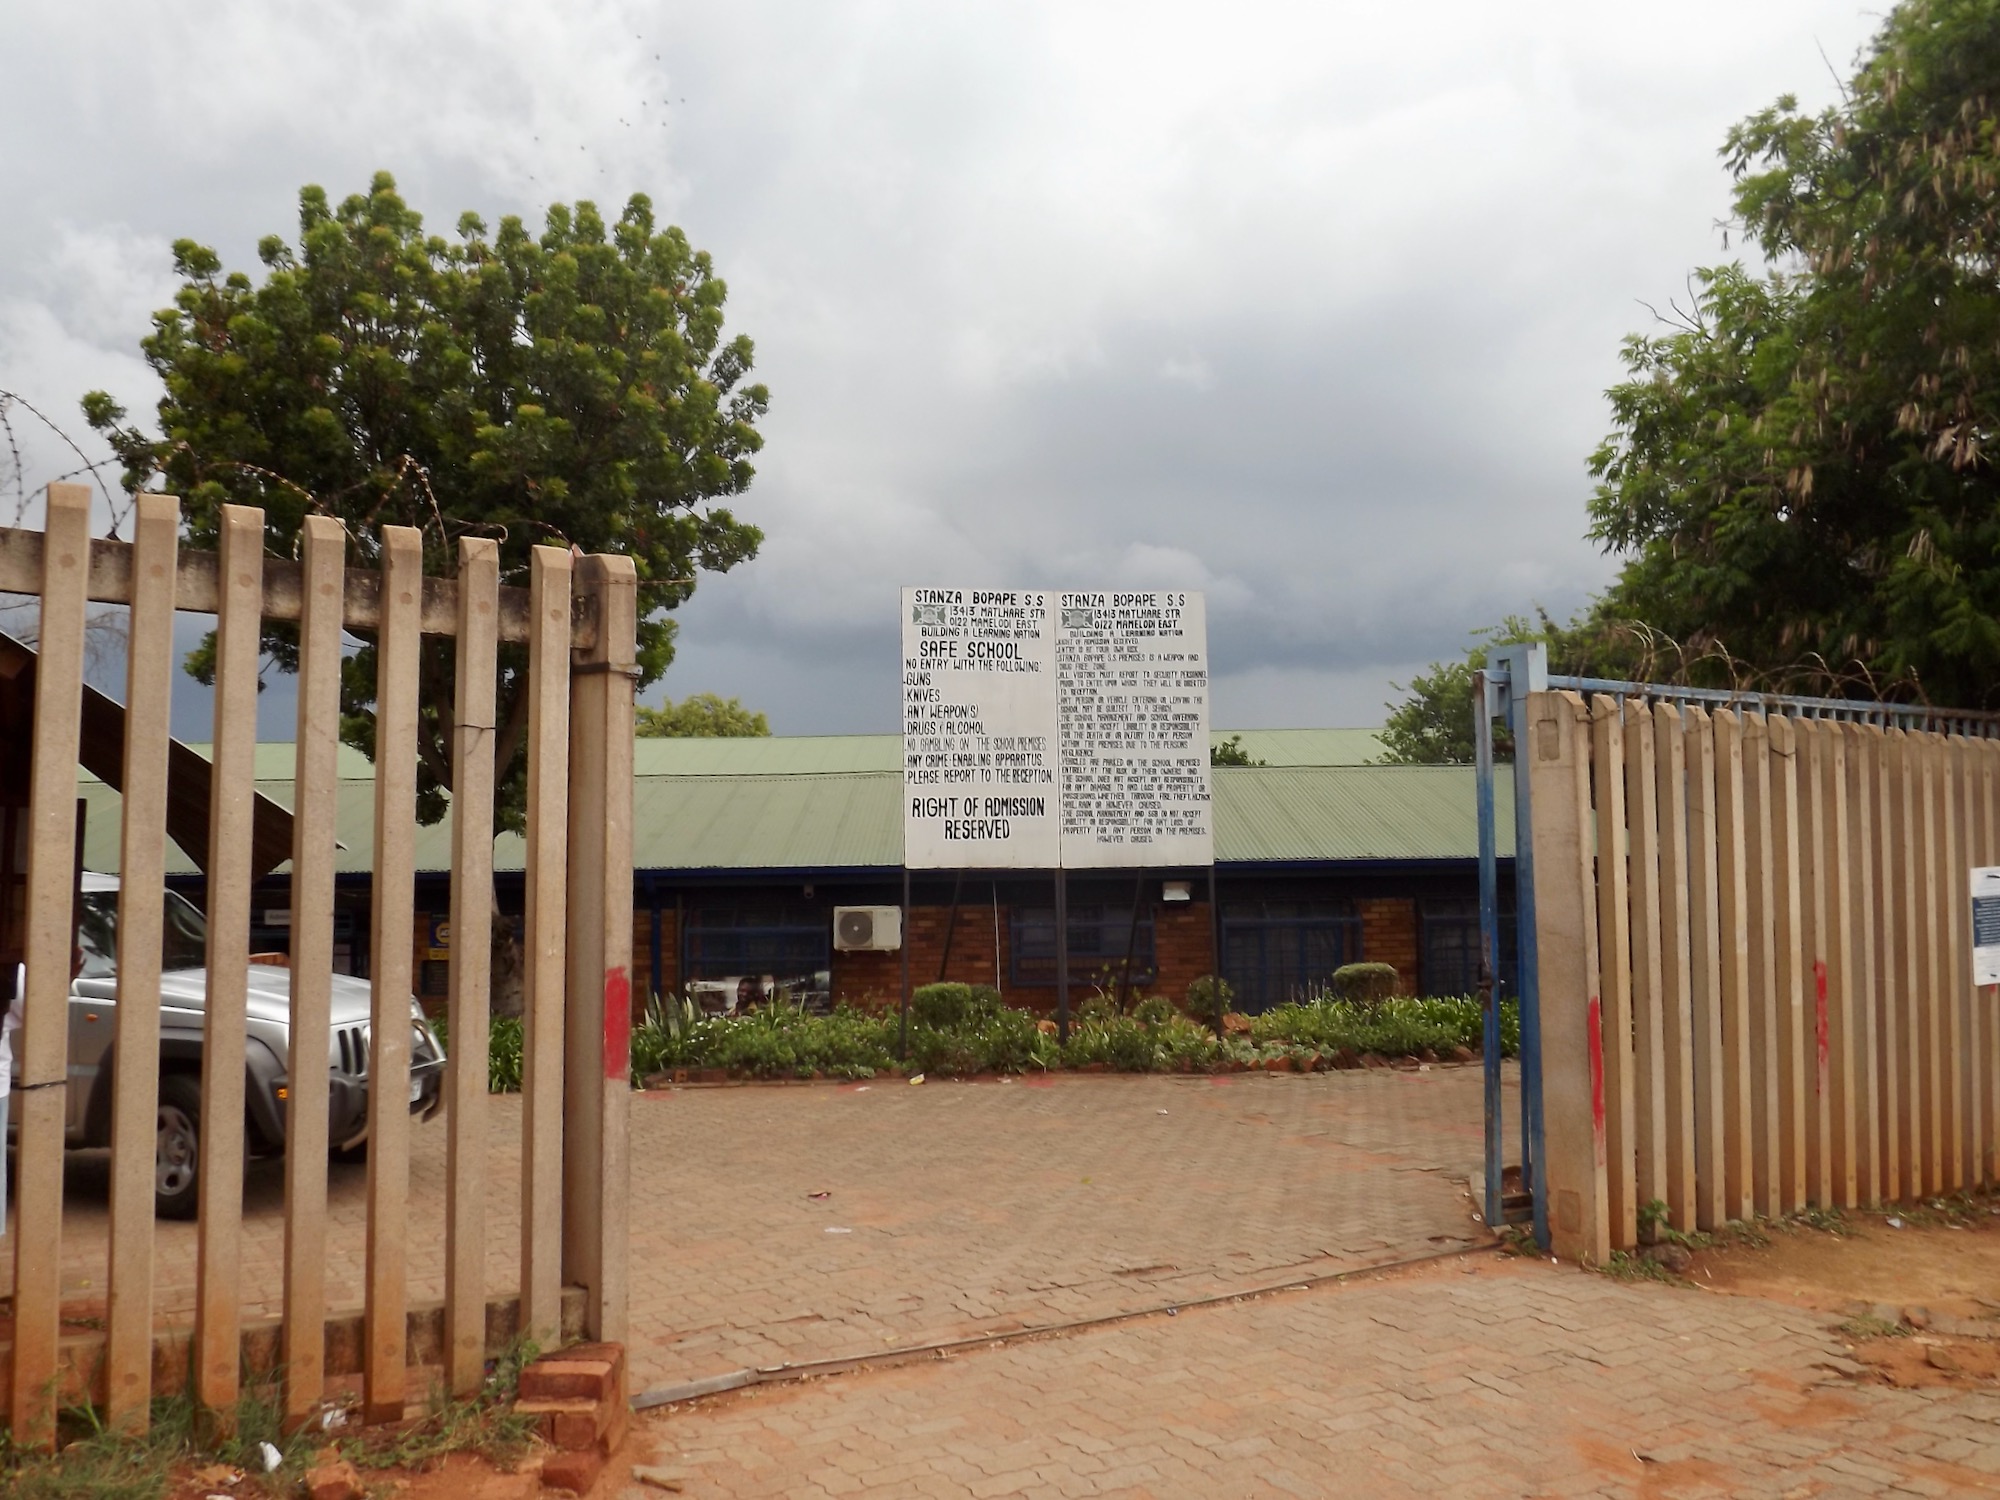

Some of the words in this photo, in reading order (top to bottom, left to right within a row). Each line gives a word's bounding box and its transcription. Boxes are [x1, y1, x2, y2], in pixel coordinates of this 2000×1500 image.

[916, 590, 962, 604] STANZA
[973, 592, 1016, 605] BOPAPE
[1062, 594, 1104, 607] STANZA
[1114, 594, 1156, 606] BOPAPE
[950, 606, 975, 616] 13413
[1030, 609, 1046, 618] STR
[1094, 609, 1116, 618] 13413
[1165, 610, 1180, 618] STR
[950, 618, 968, 626] 0122
[971, 618, 1012, 628] MAMELODI
[1017, 620, 1038, 628] EAST
[1094, 620, 1112, 628] 0122
[1116, 620, 1156, 628] MAMELODI
[1158, 620, 1178, 628] EAST
[922, 628, 960, 636] BUILDING
[973, 628, 1010, 638] LEARNING
[1014, 630, 1040, 638] NATION
[920, 640, 958, 658] SAFE
[968, 642, 1022, 660] SCHOOL
[906, 658, 916, 670] NO
[920, 659, 948, 670] ENTRY
[954, 660, 974, 670] WITH
[979, 660, 993, 671] THE
[930, 704, 978, 718] WEAPON(S)
[946, 722, 986, 734] ALCOHOL
[920, 738, 954, 750] GAMBLING
[960, 738, 969, 750] ON
[976, 738, 990, 750] THE
[993, 738, 1017, 750] SCHOOL
[1018, 737, 1046, 750] PREMISES
[944, 769, 976, 783] REPORT
[980, 769, 990, 782] TO
[996, 769, 1010, 783] THE
[912, 798, 958, 817] RIGHT
[964, 798, 978, 816] OF
[985, 798, 1044, 816] ADMISSION
[944, 820, 1010, 840] RESERVED
